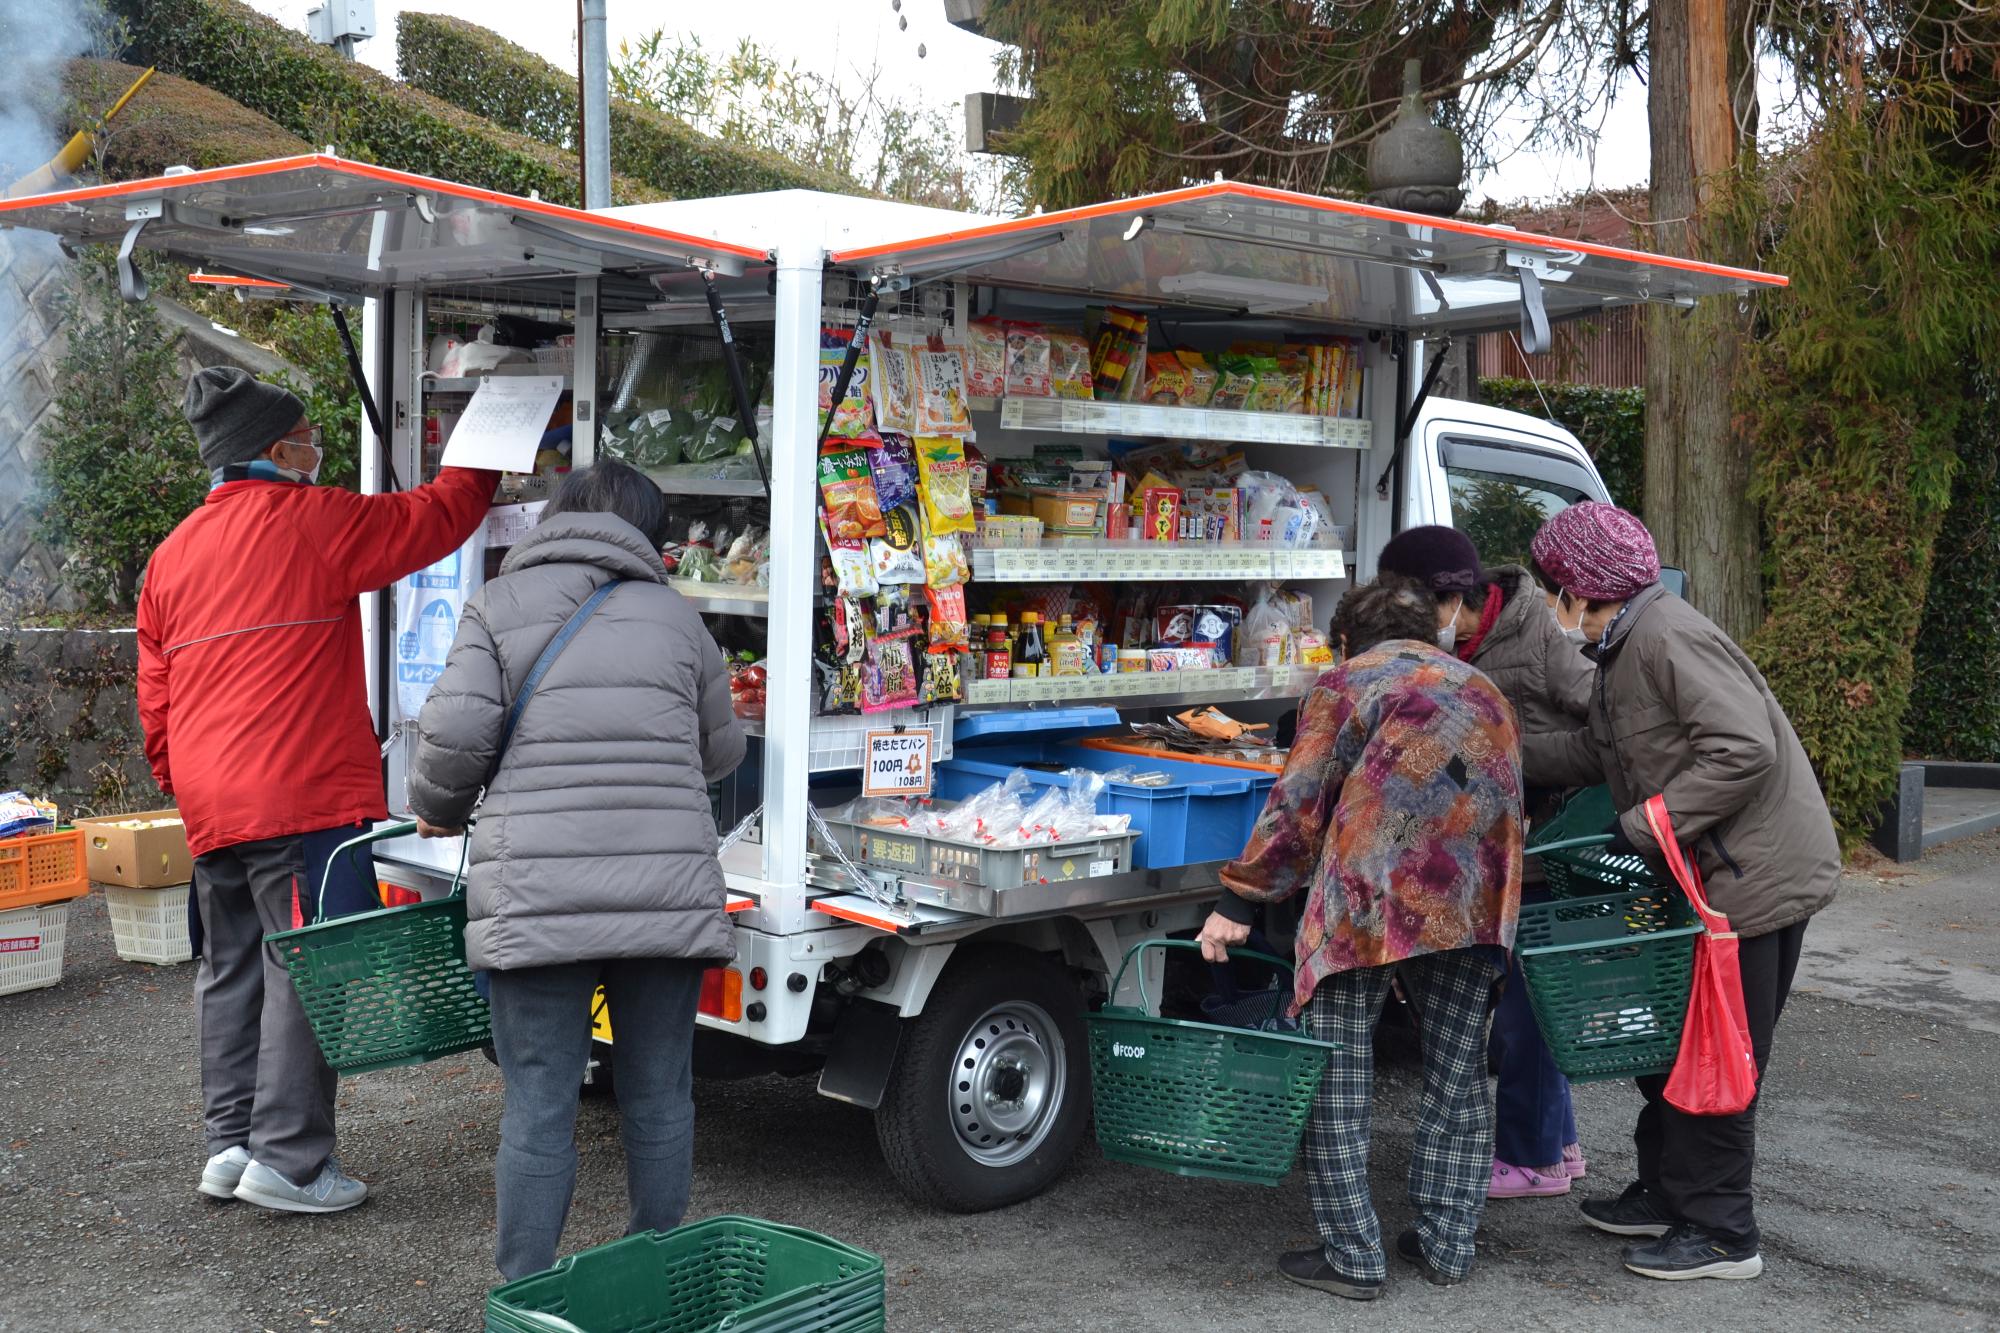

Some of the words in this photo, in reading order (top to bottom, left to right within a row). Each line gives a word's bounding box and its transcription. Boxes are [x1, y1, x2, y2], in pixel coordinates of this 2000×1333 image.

[873, 738, 926, 752] 焼きたてパン
[873, 759, 903, 773] 100円
[872, 837, 917, 864] 要返却
